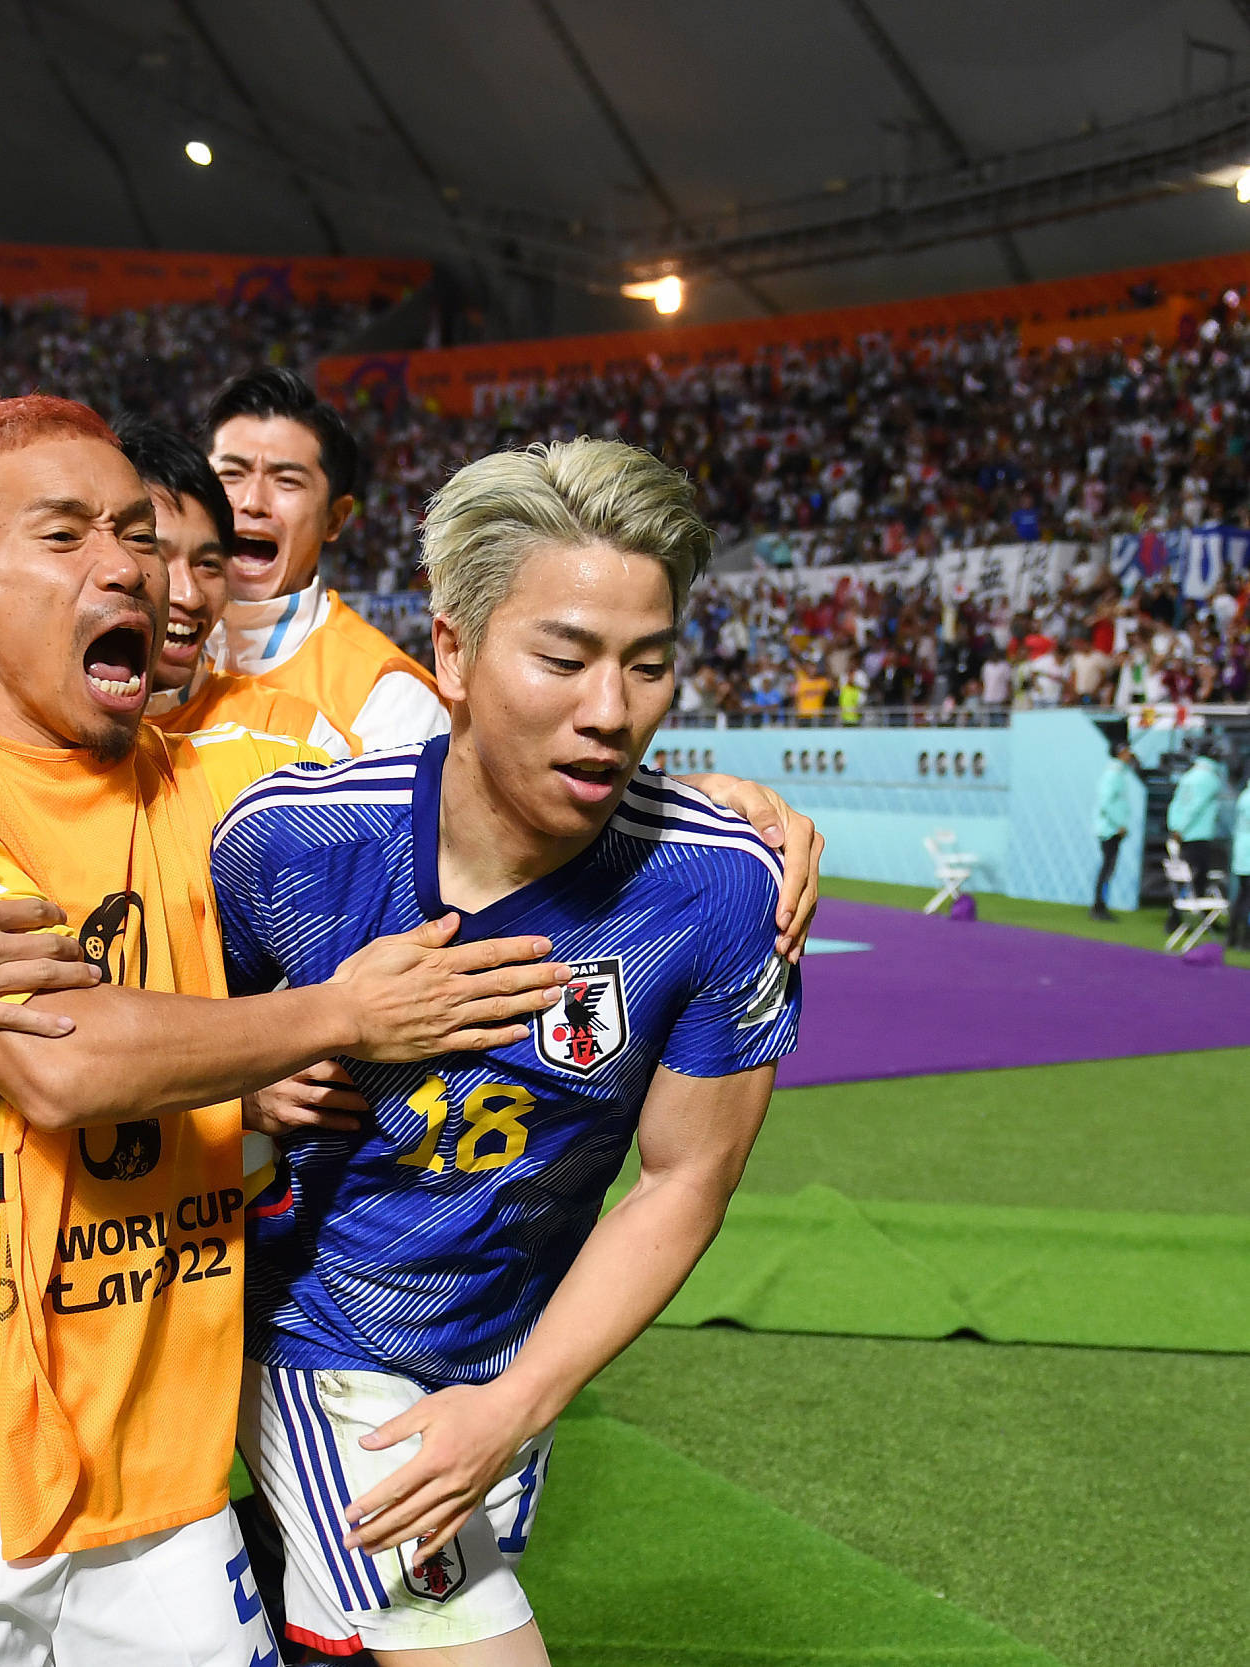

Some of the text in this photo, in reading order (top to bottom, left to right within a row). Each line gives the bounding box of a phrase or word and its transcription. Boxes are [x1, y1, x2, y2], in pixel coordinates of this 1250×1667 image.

[570, 962, 600, 977] PAN
[563, 1039, 604, 1060] JFA
[396, 1074, 538, 1174] 18
[56, 1187, 244, 1263] WORL CUP
[497, 1440, 554, 1554] 1
